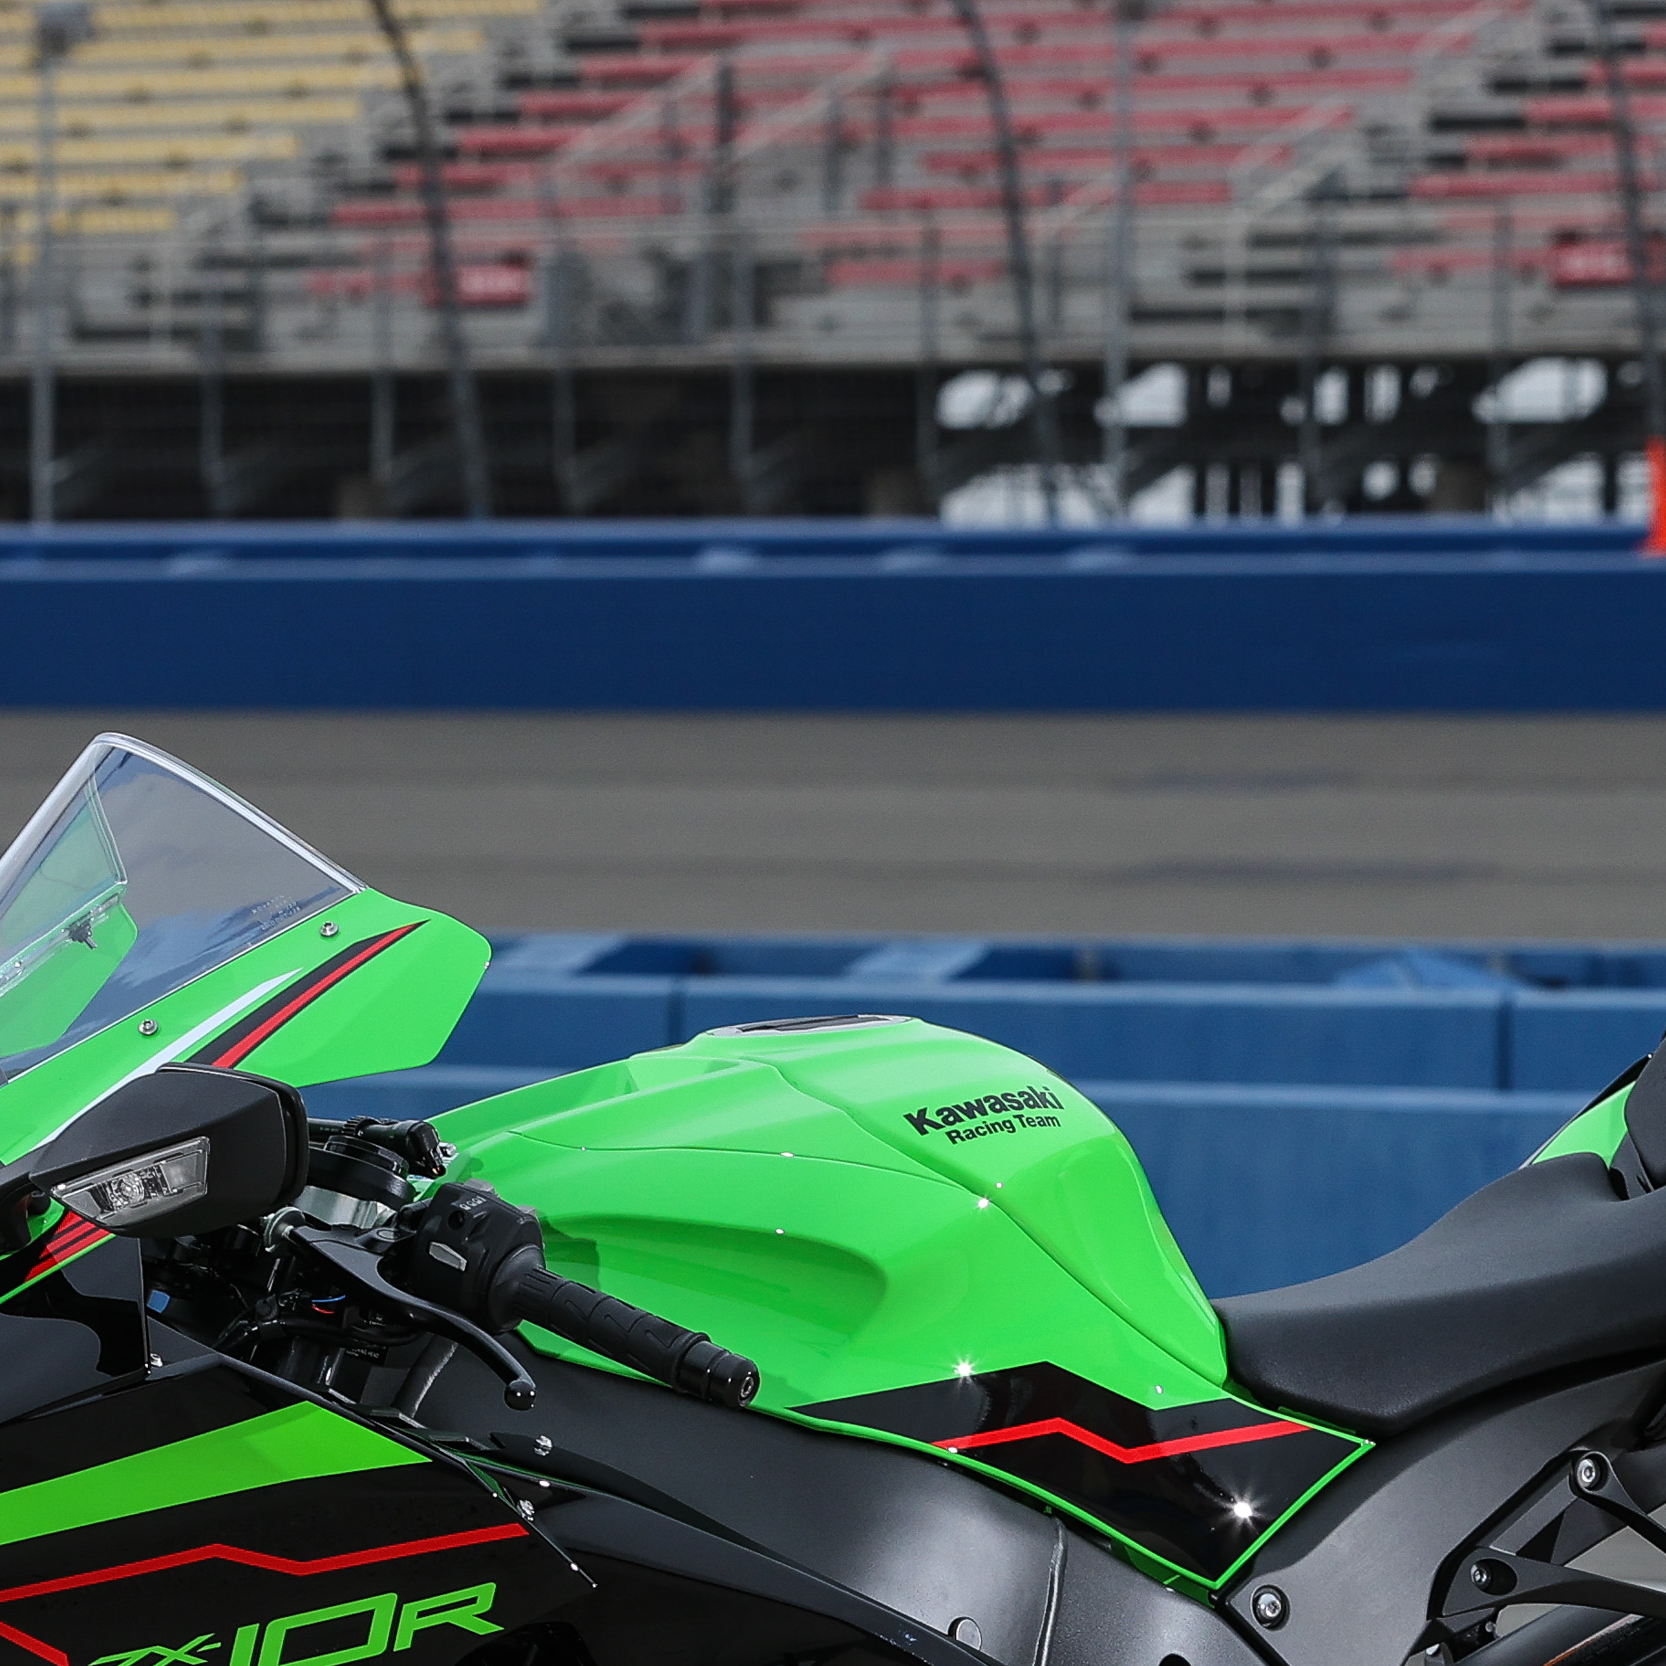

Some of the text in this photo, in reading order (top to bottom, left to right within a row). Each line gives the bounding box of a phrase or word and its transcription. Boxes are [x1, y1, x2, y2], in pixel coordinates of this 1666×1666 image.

[903, 1085, 1064, 1136] Kawasaki
[945, 1113, 1061, 1145] Racing Team
